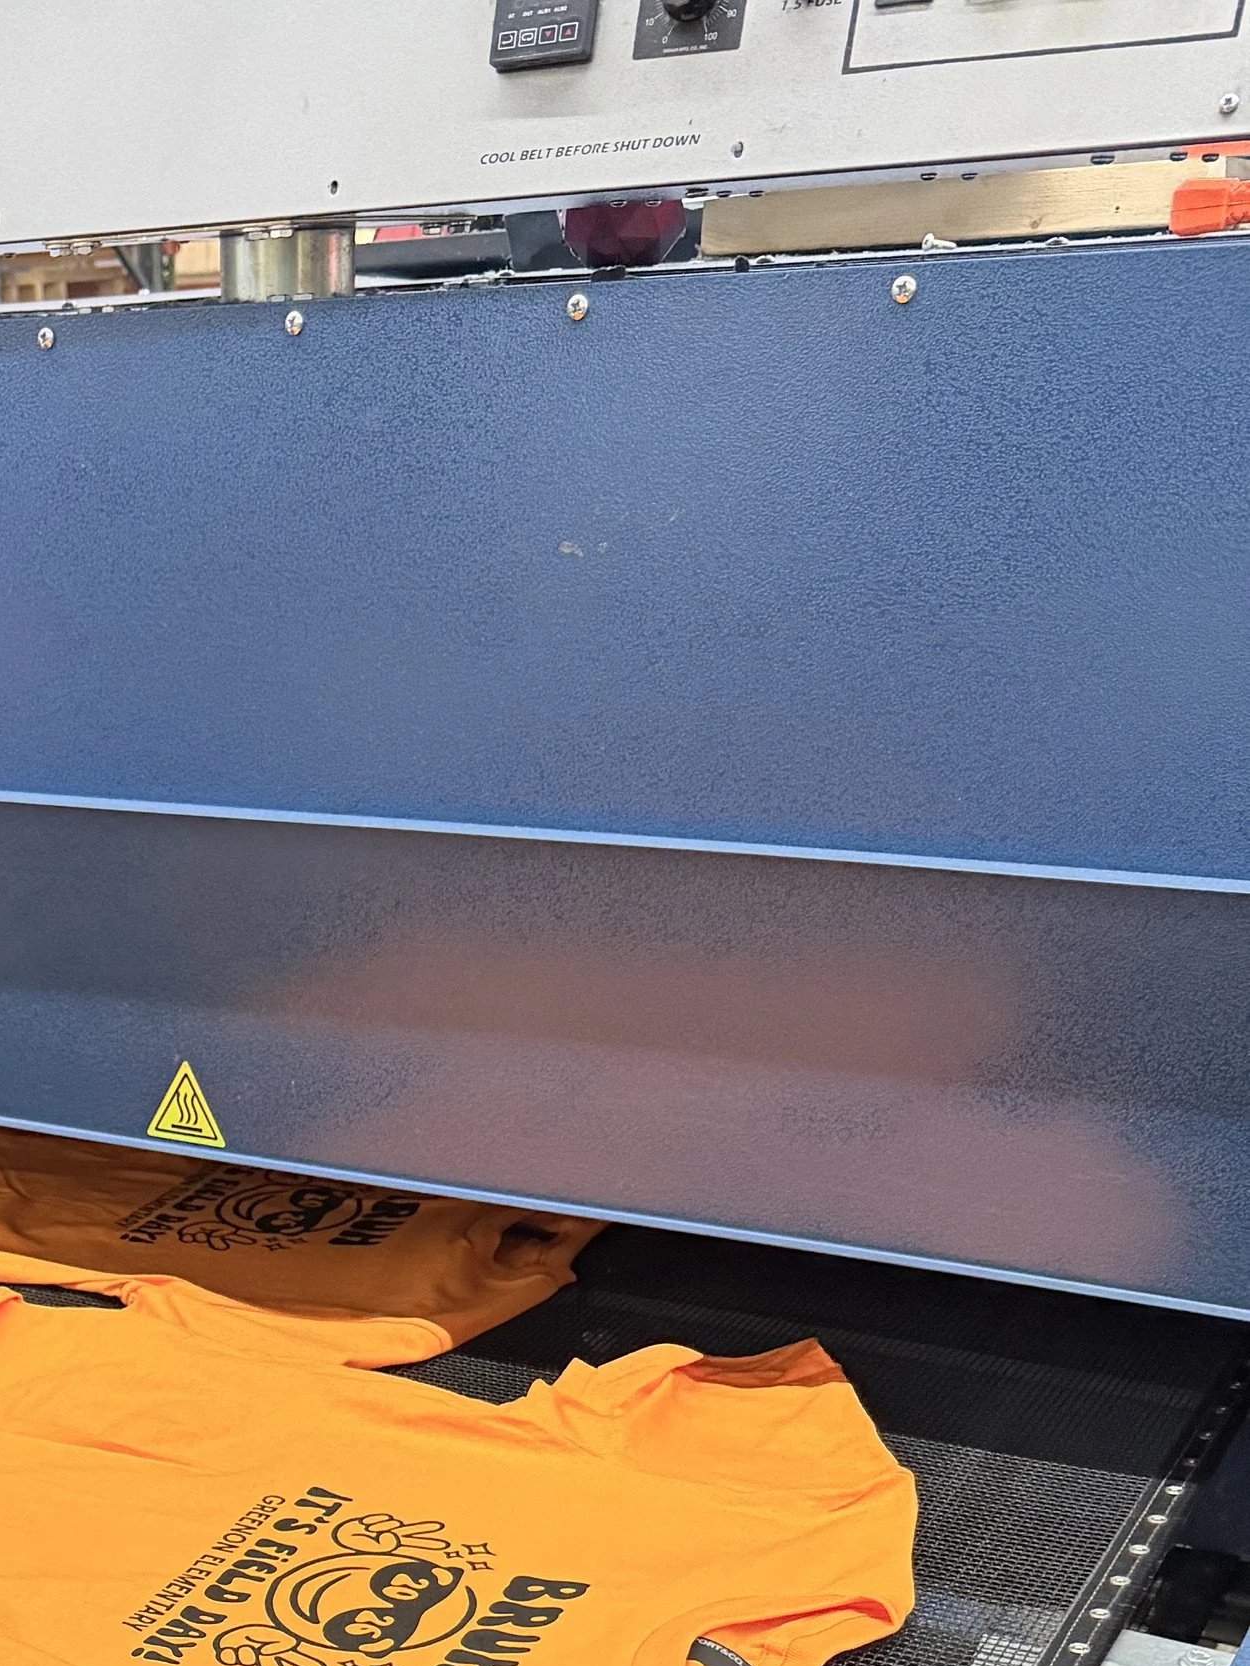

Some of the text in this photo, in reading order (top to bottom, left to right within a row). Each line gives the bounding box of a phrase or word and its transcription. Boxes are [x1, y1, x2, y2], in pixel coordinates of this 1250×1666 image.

[480, 133, 702, 165] COOL BELT BEFORE SHUT DOWN
[271, 1485, 354, 1536] IT'S
[121, 1493, 288, 1632] GREENON ELEMENTARY
[131, 1604, 228, 1666] DAY!
